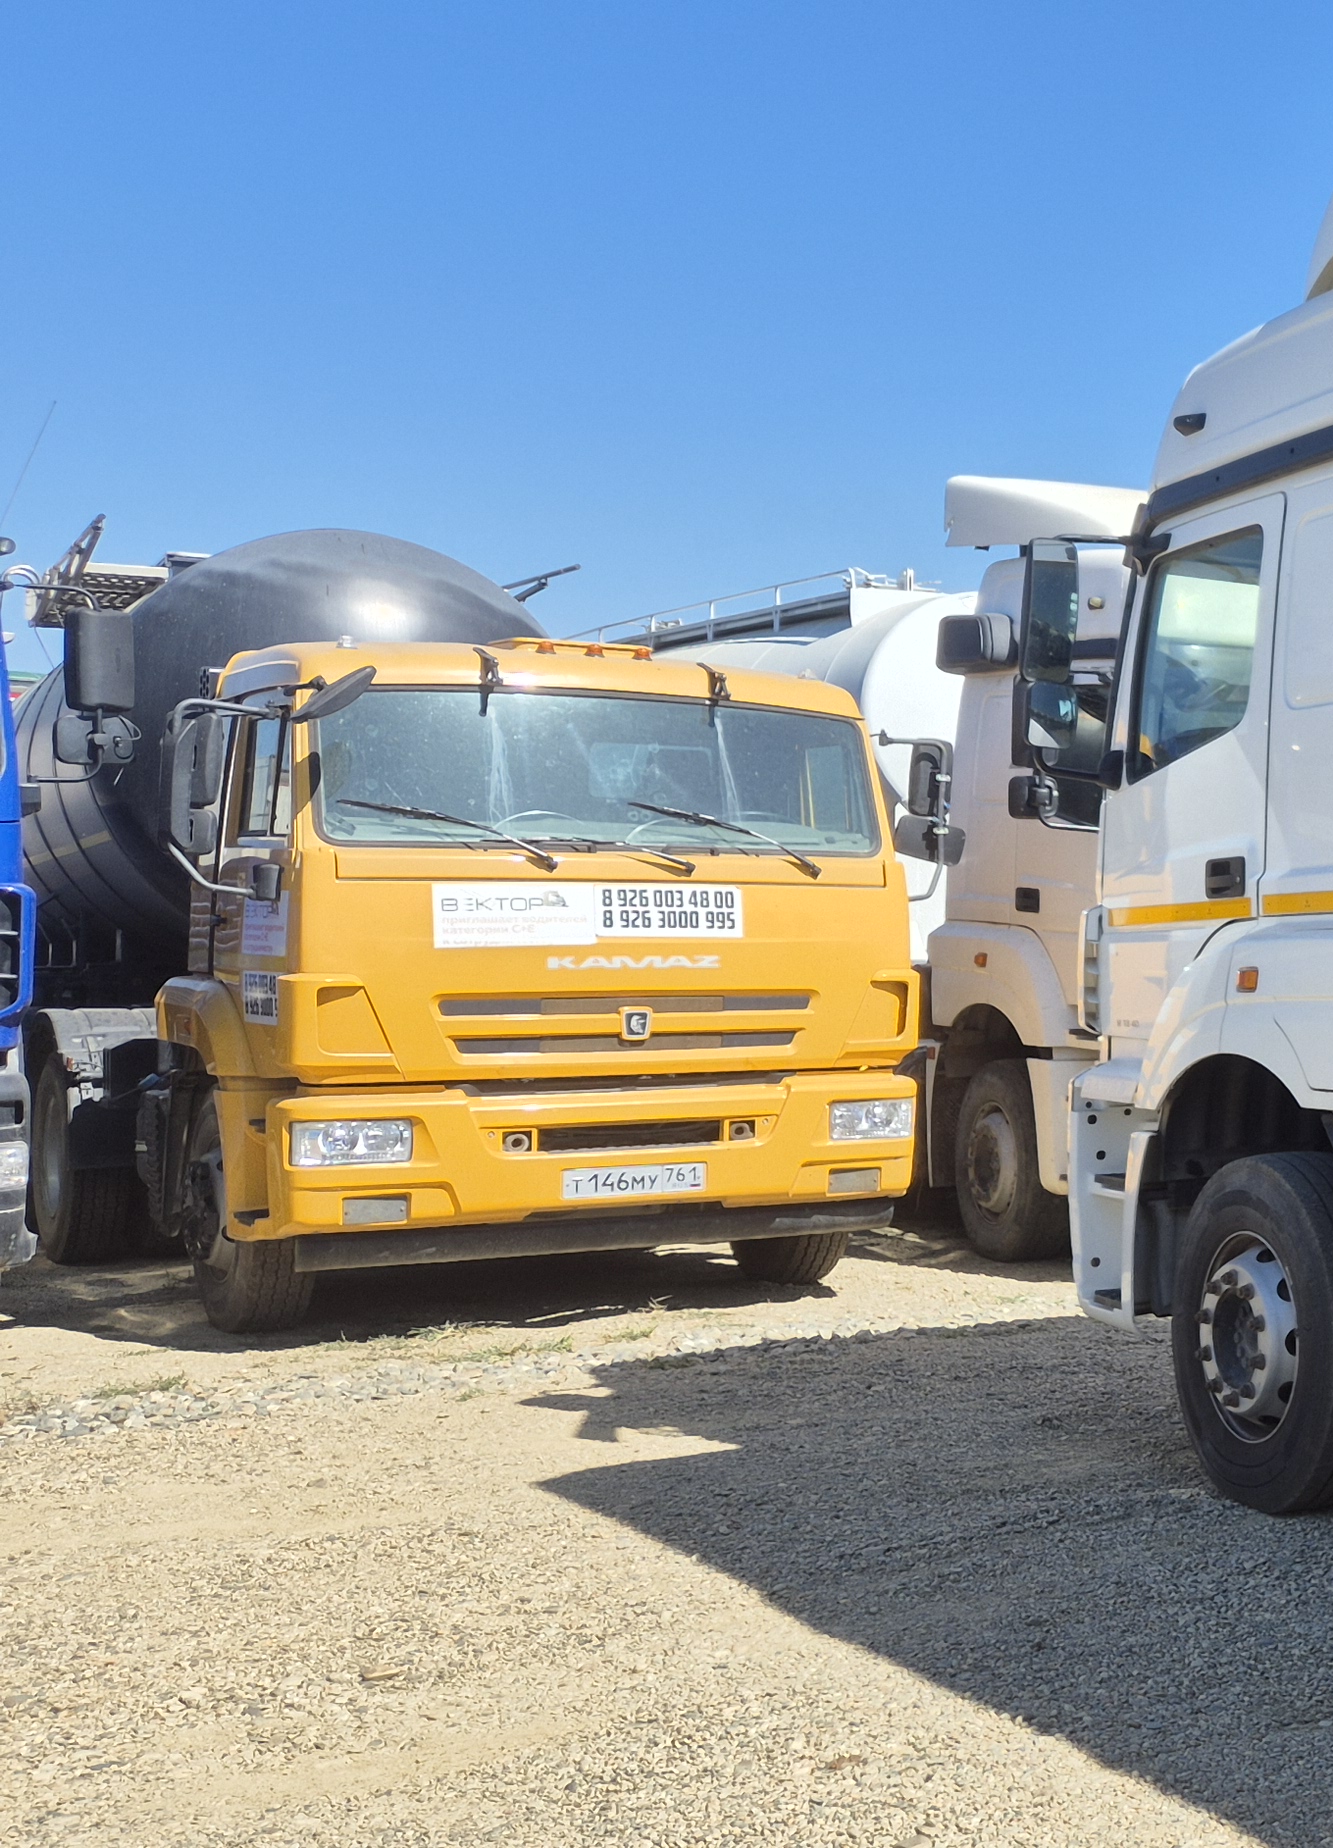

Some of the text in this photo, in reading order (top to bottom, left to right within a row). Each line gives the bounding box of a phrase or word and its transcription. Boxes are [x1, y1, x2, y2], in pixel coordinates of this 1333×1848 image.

[441, 897, 544, 912] ВЕКТОР
[602, 889, 735, 909] 8 926 003 48 00
[603, 909, 735, 930] 8 926 3000 995
[547, 955, 721, 970] KAMAZ
[665, 1166, 698, 1183] 761
